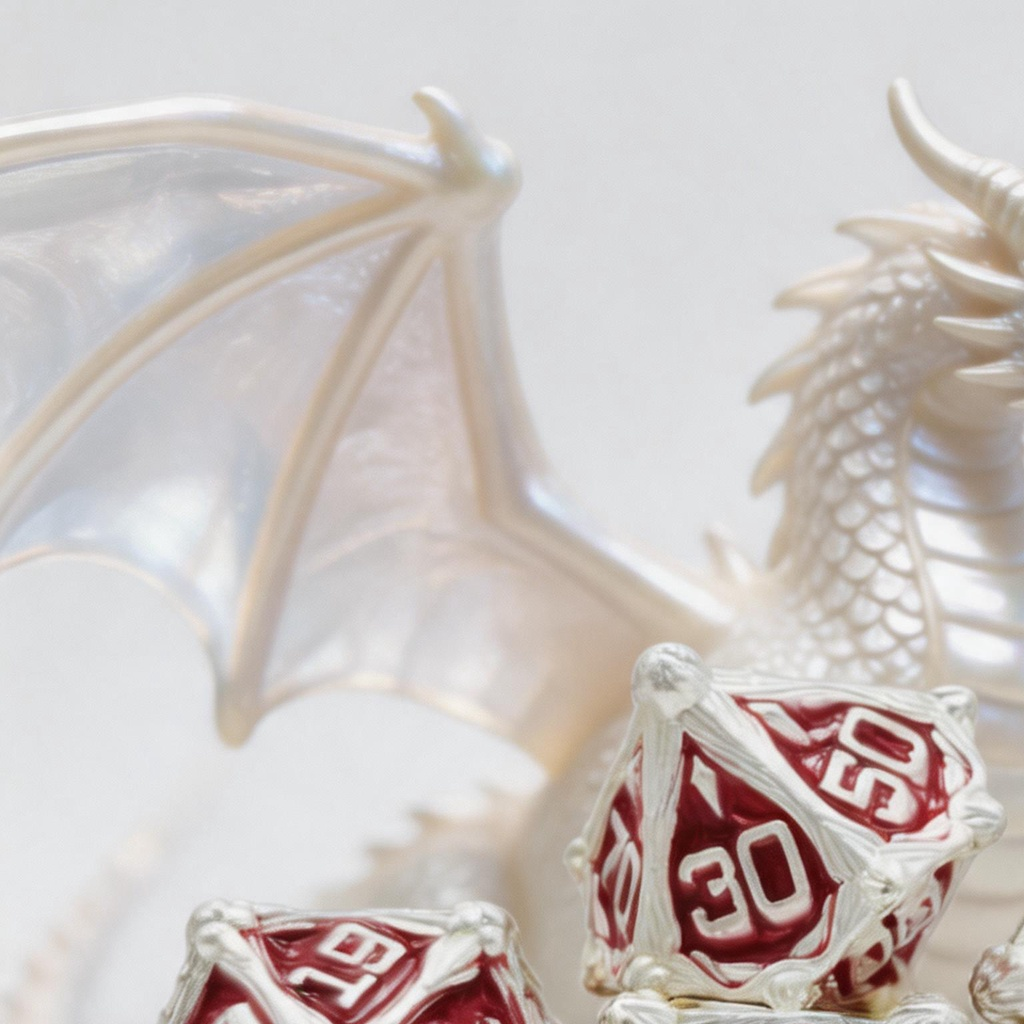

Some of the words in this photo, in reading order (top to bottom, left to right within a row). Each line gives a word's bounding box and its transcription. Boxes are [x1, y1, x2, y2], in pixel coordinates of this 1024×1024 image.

[820, 706, 929, 827] 50
[678, 819, 814, 940] 30
[287, 922, 408, 1009] 19
